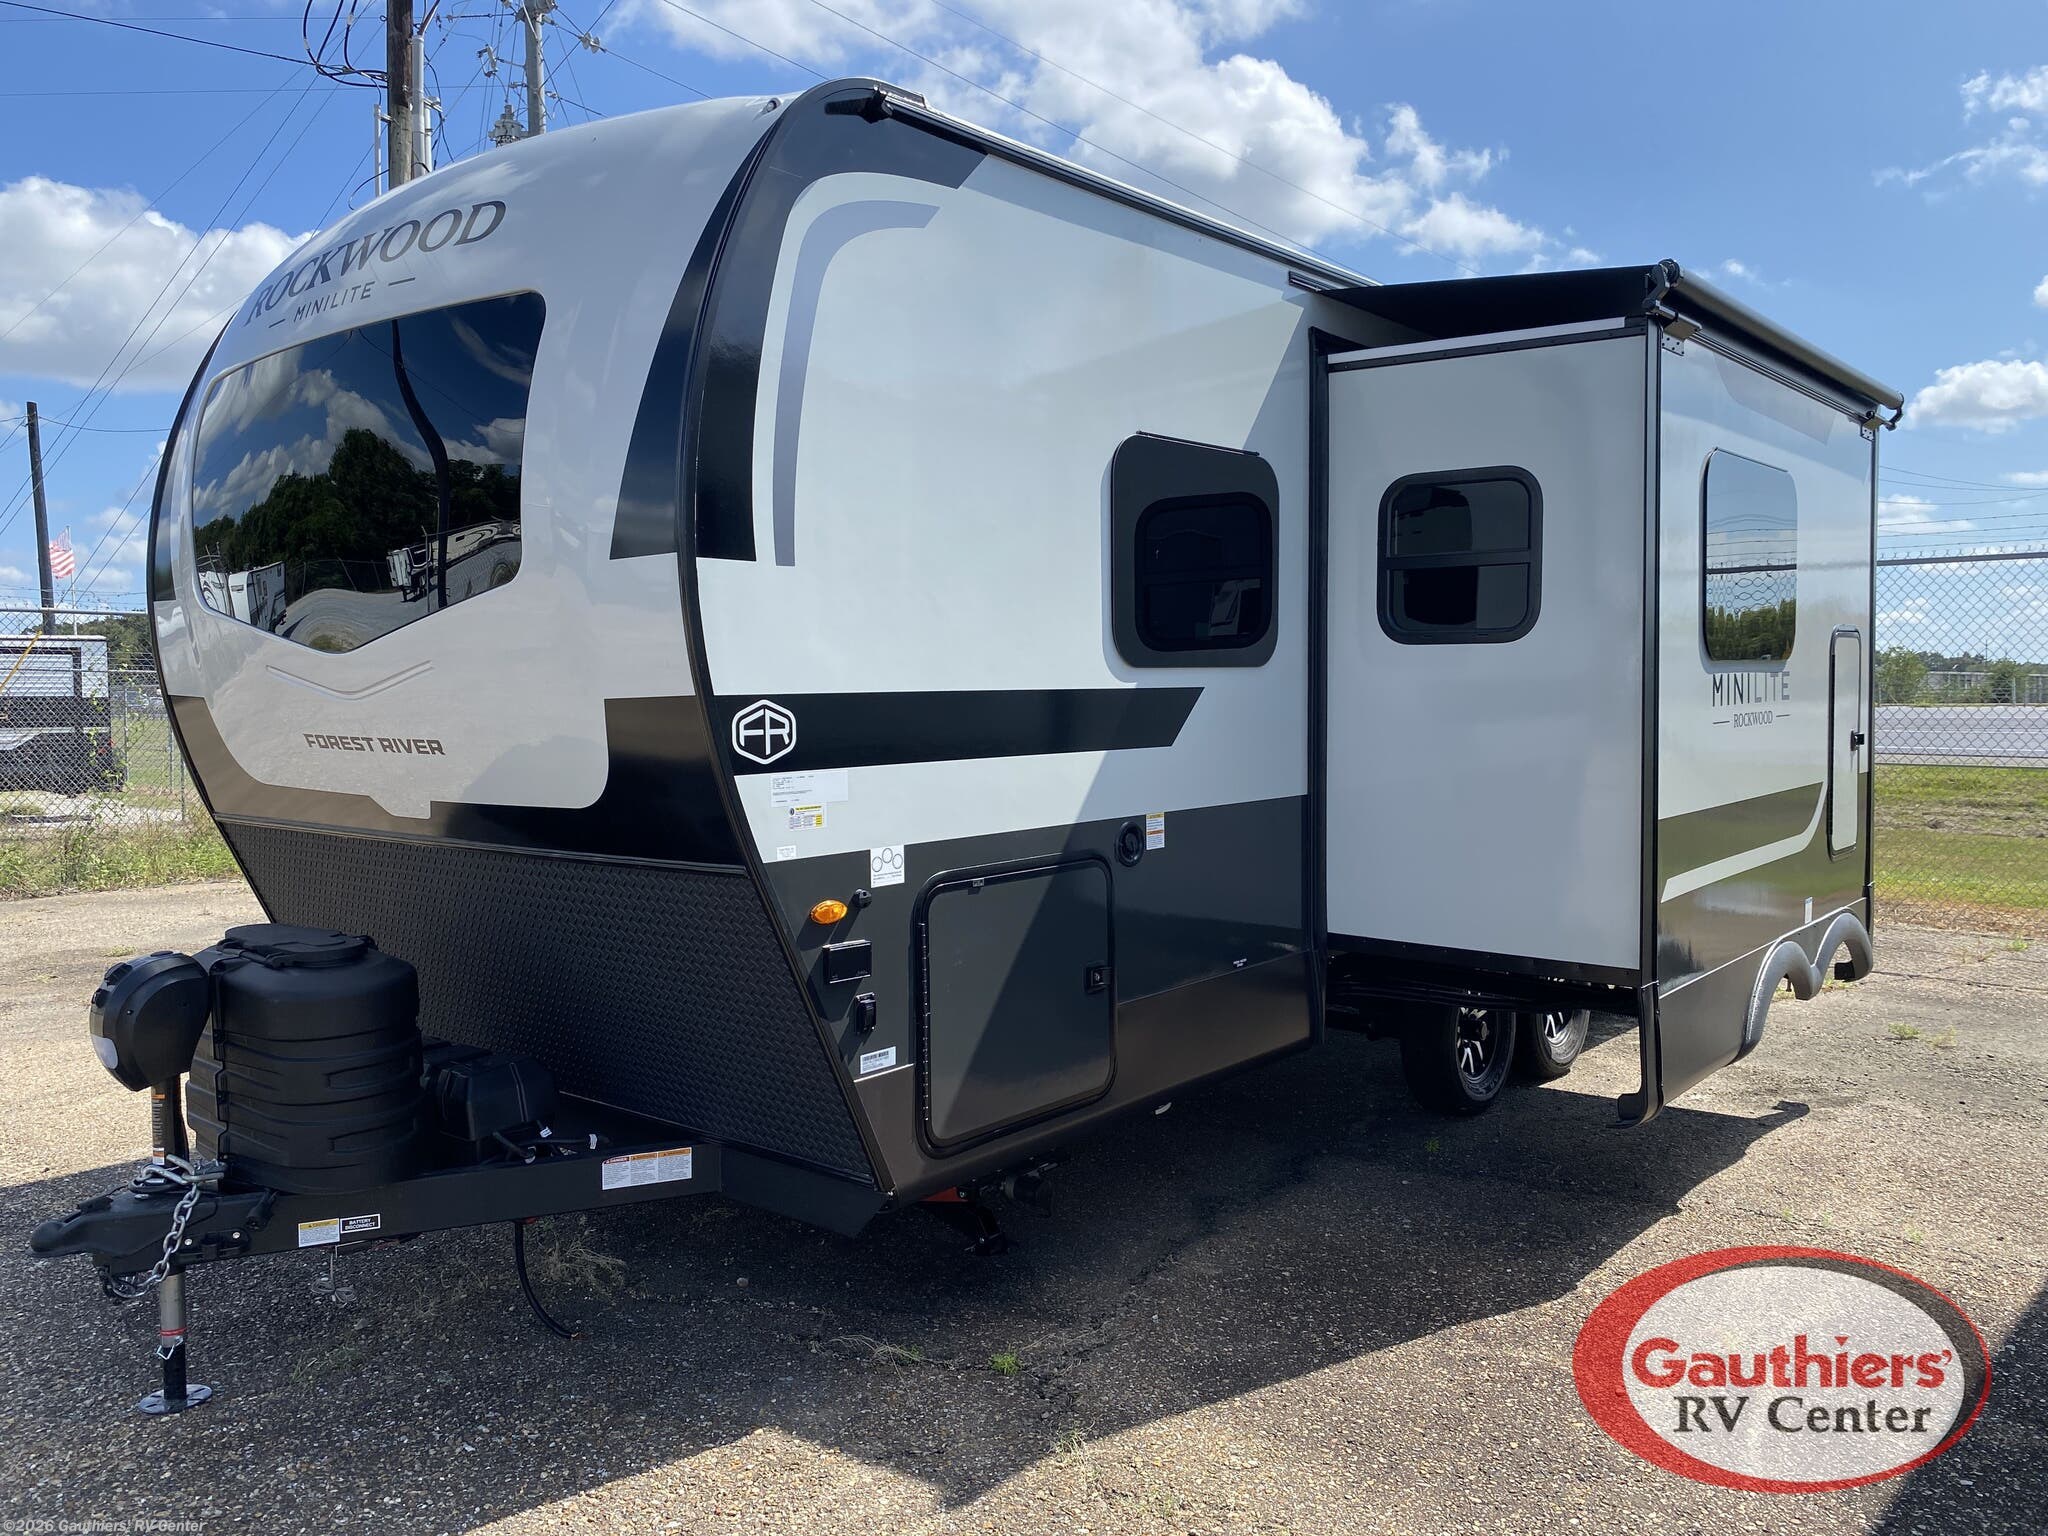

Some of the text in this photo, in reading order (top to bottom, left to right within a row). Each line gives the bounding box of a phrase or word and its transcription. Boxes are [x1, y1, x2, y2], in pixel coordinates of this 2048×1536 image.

[244, 200, 507, 327] ROCKWOOD
[293, 281, 375, 323] MINILITE
[1712, 671, 1790, 707] MINILITE
[1733, 710, 1774, 728] ROCKWOOD
[303, 733, 446, 756] FOREST RIVER
